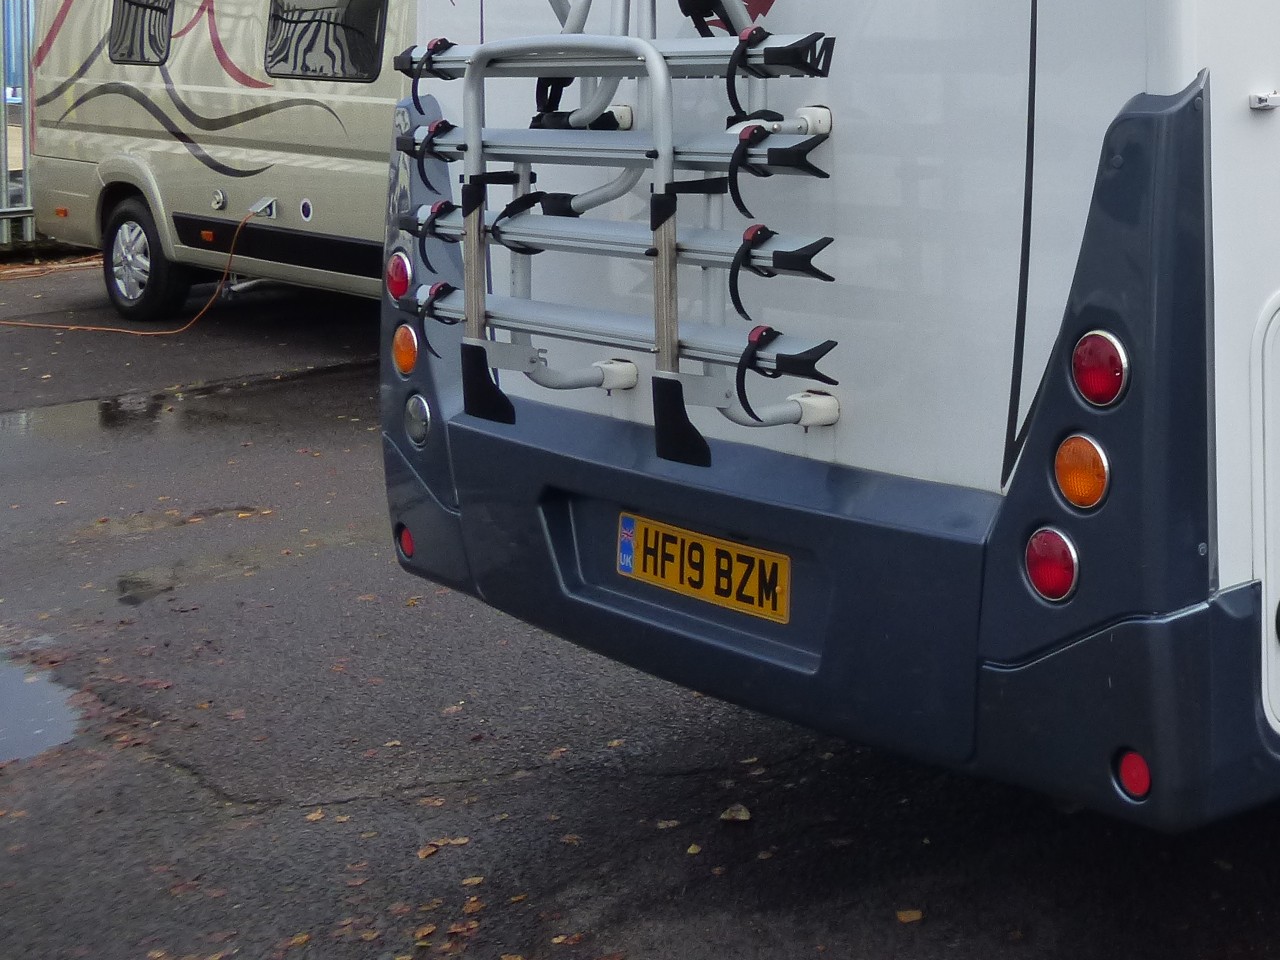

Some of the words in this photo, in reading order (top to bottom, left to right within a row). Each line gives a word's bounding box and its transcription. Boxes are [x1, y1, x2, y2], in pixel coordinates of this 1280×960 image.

[619, 551, 632, 568] UK
[641, 527, 705, 590] HF19
[714, 547, 779, 611] BZM
